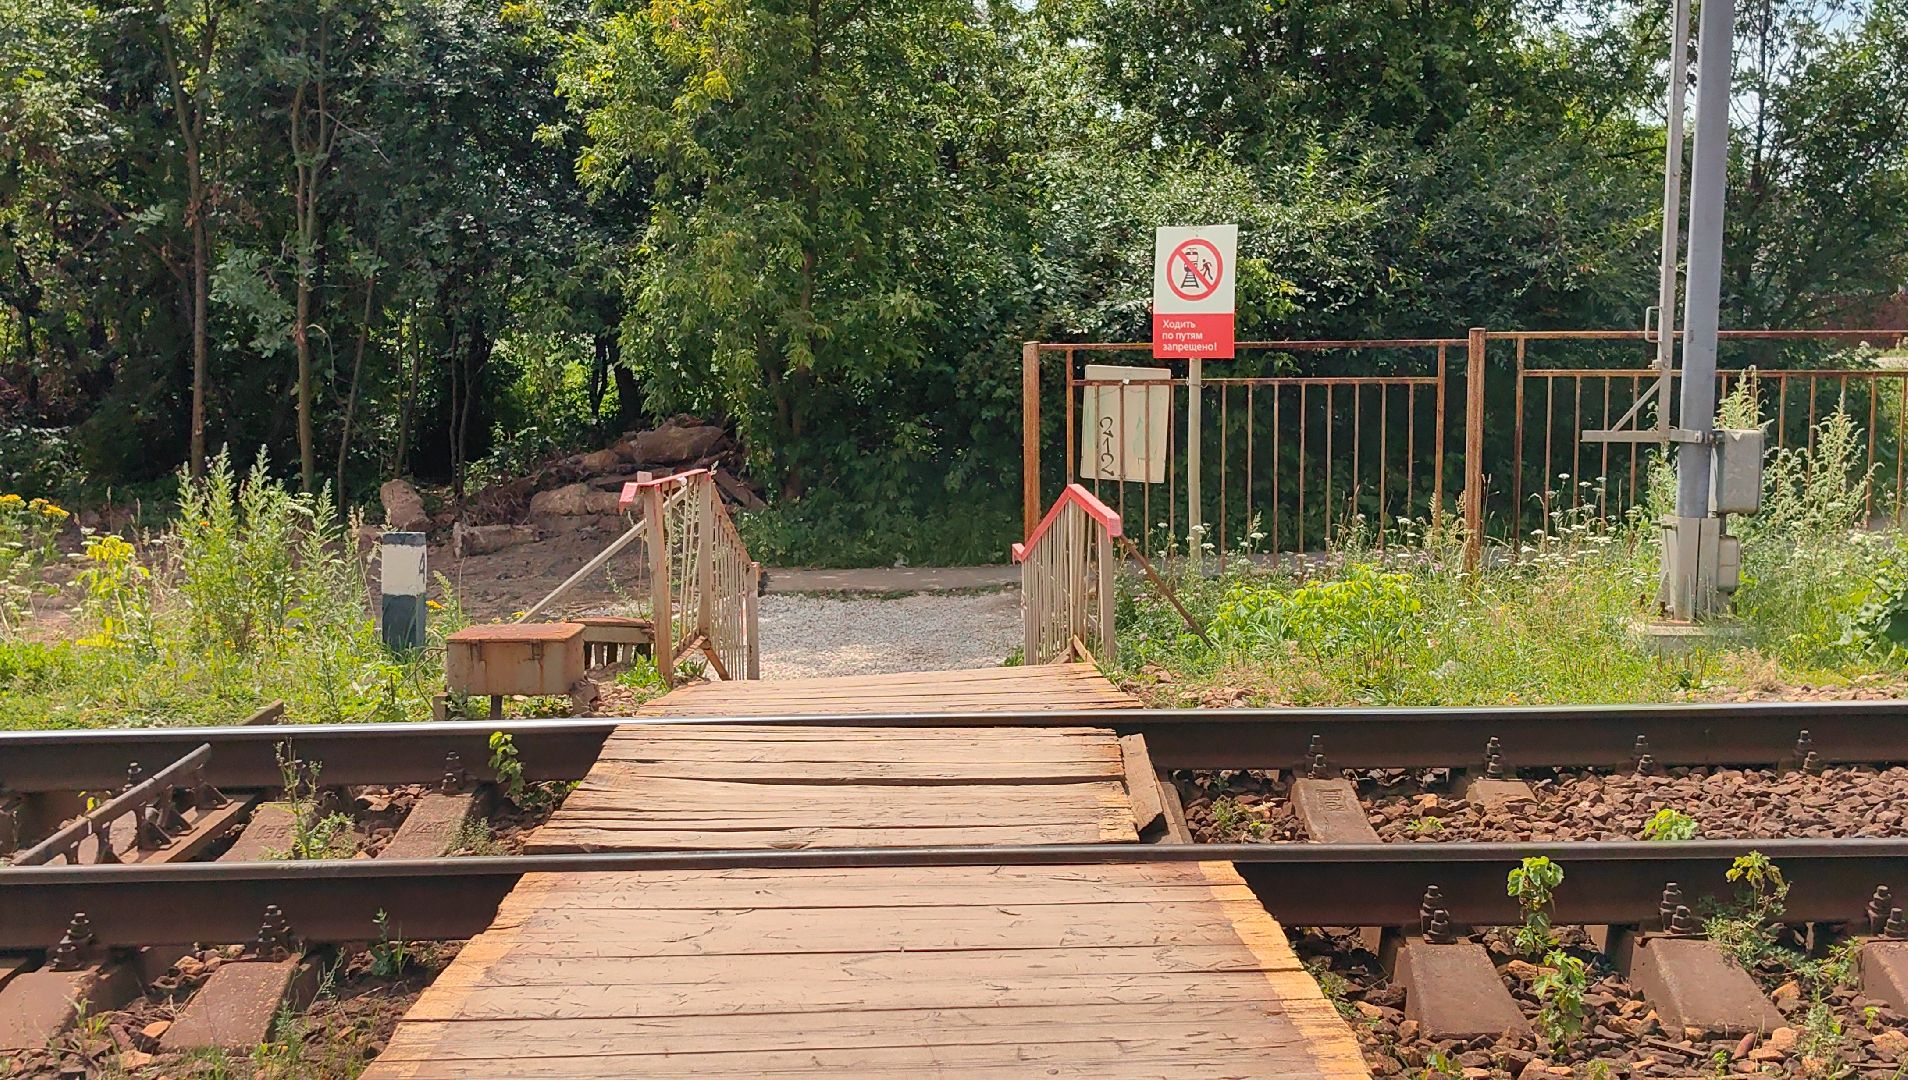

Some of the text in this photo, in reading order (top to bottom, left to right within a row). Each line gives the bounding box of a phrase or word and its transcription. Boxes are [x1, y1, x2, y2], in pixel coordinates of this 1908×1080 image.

[1162, 319, 1196, 330] Ходить
[1162, 332, 1203, 342] по путям
[1162, 342, 1217, 353] запрещено!
